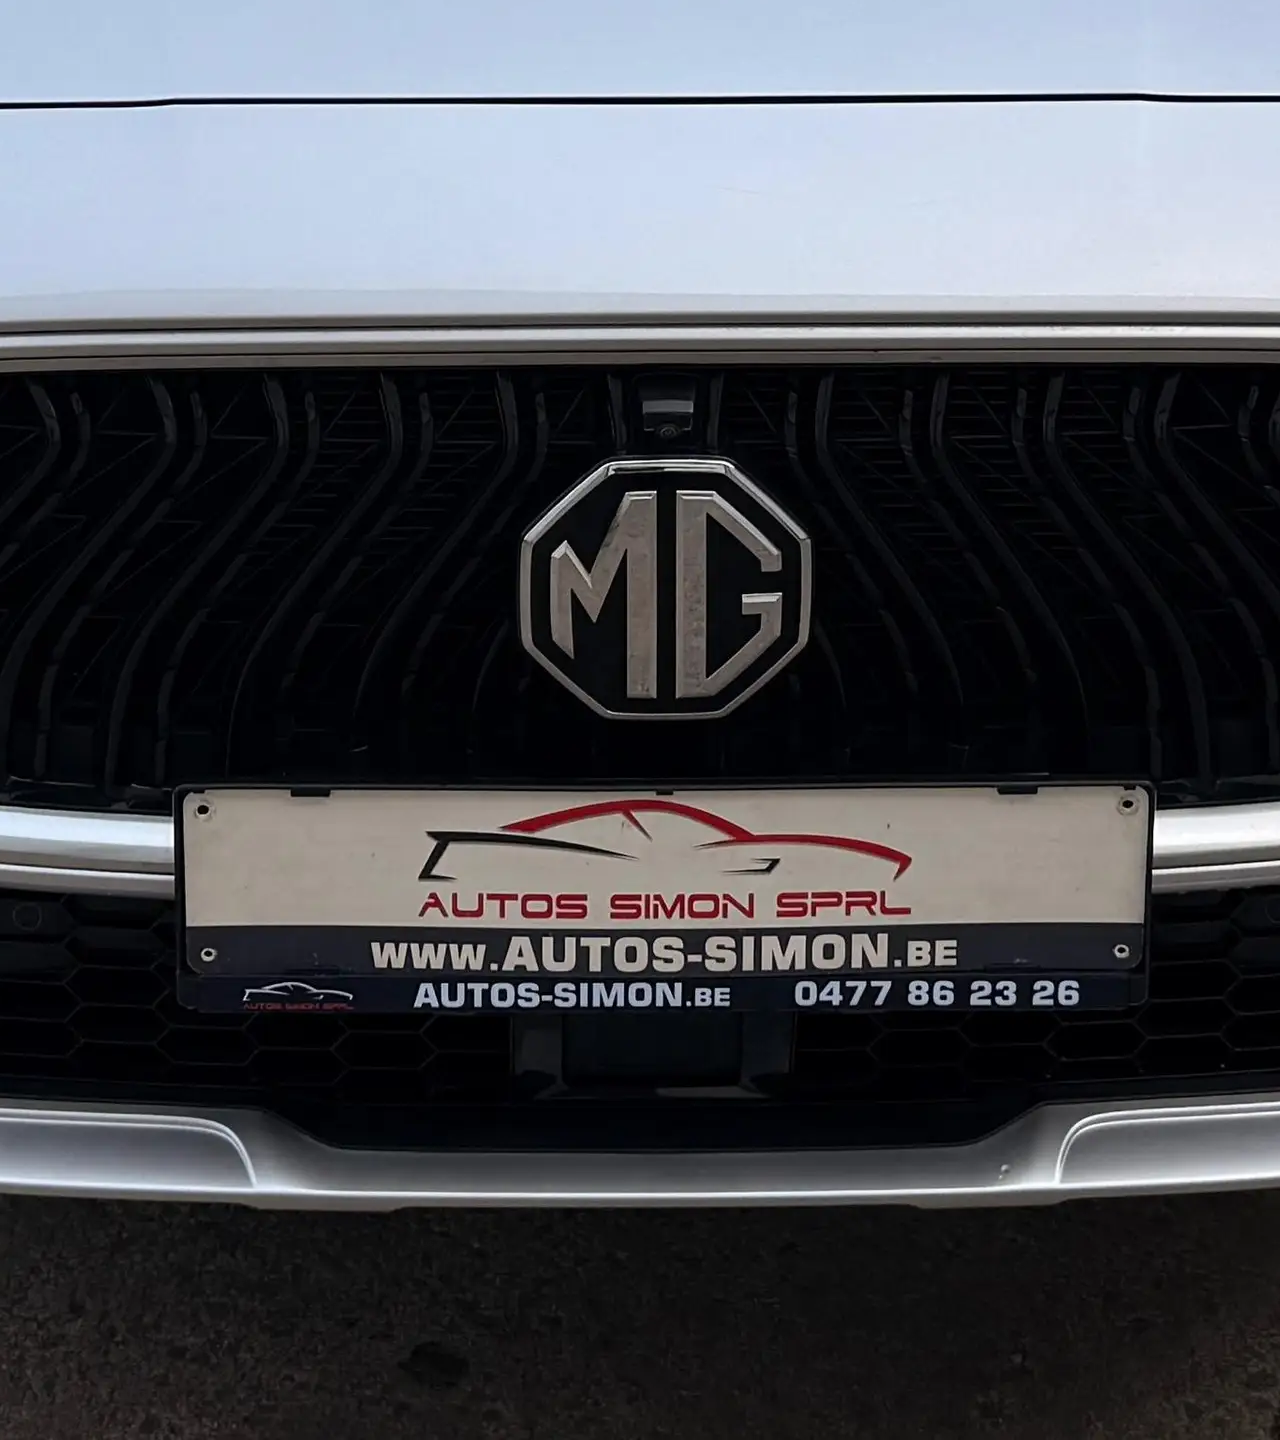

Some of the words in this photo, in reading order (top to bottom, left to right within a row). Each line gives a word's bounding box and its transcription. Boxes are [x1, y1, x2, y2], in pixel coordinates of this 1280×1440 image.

[549, 489, 784, 699] MG
[418, 891, 588, 920] AUTOS
[609, 892, 755, 921] SIMON
[776, 889, 912, 918] SPRL
[413, 981, 731, 1009] AUTOS-SIMON.BE
[794, 980, 892, 1007] 0477
[907, 979, 955, 1007] 86
[969, 979, 1017, 1007] 23
[1032, 979, 1080, 1007] 26
